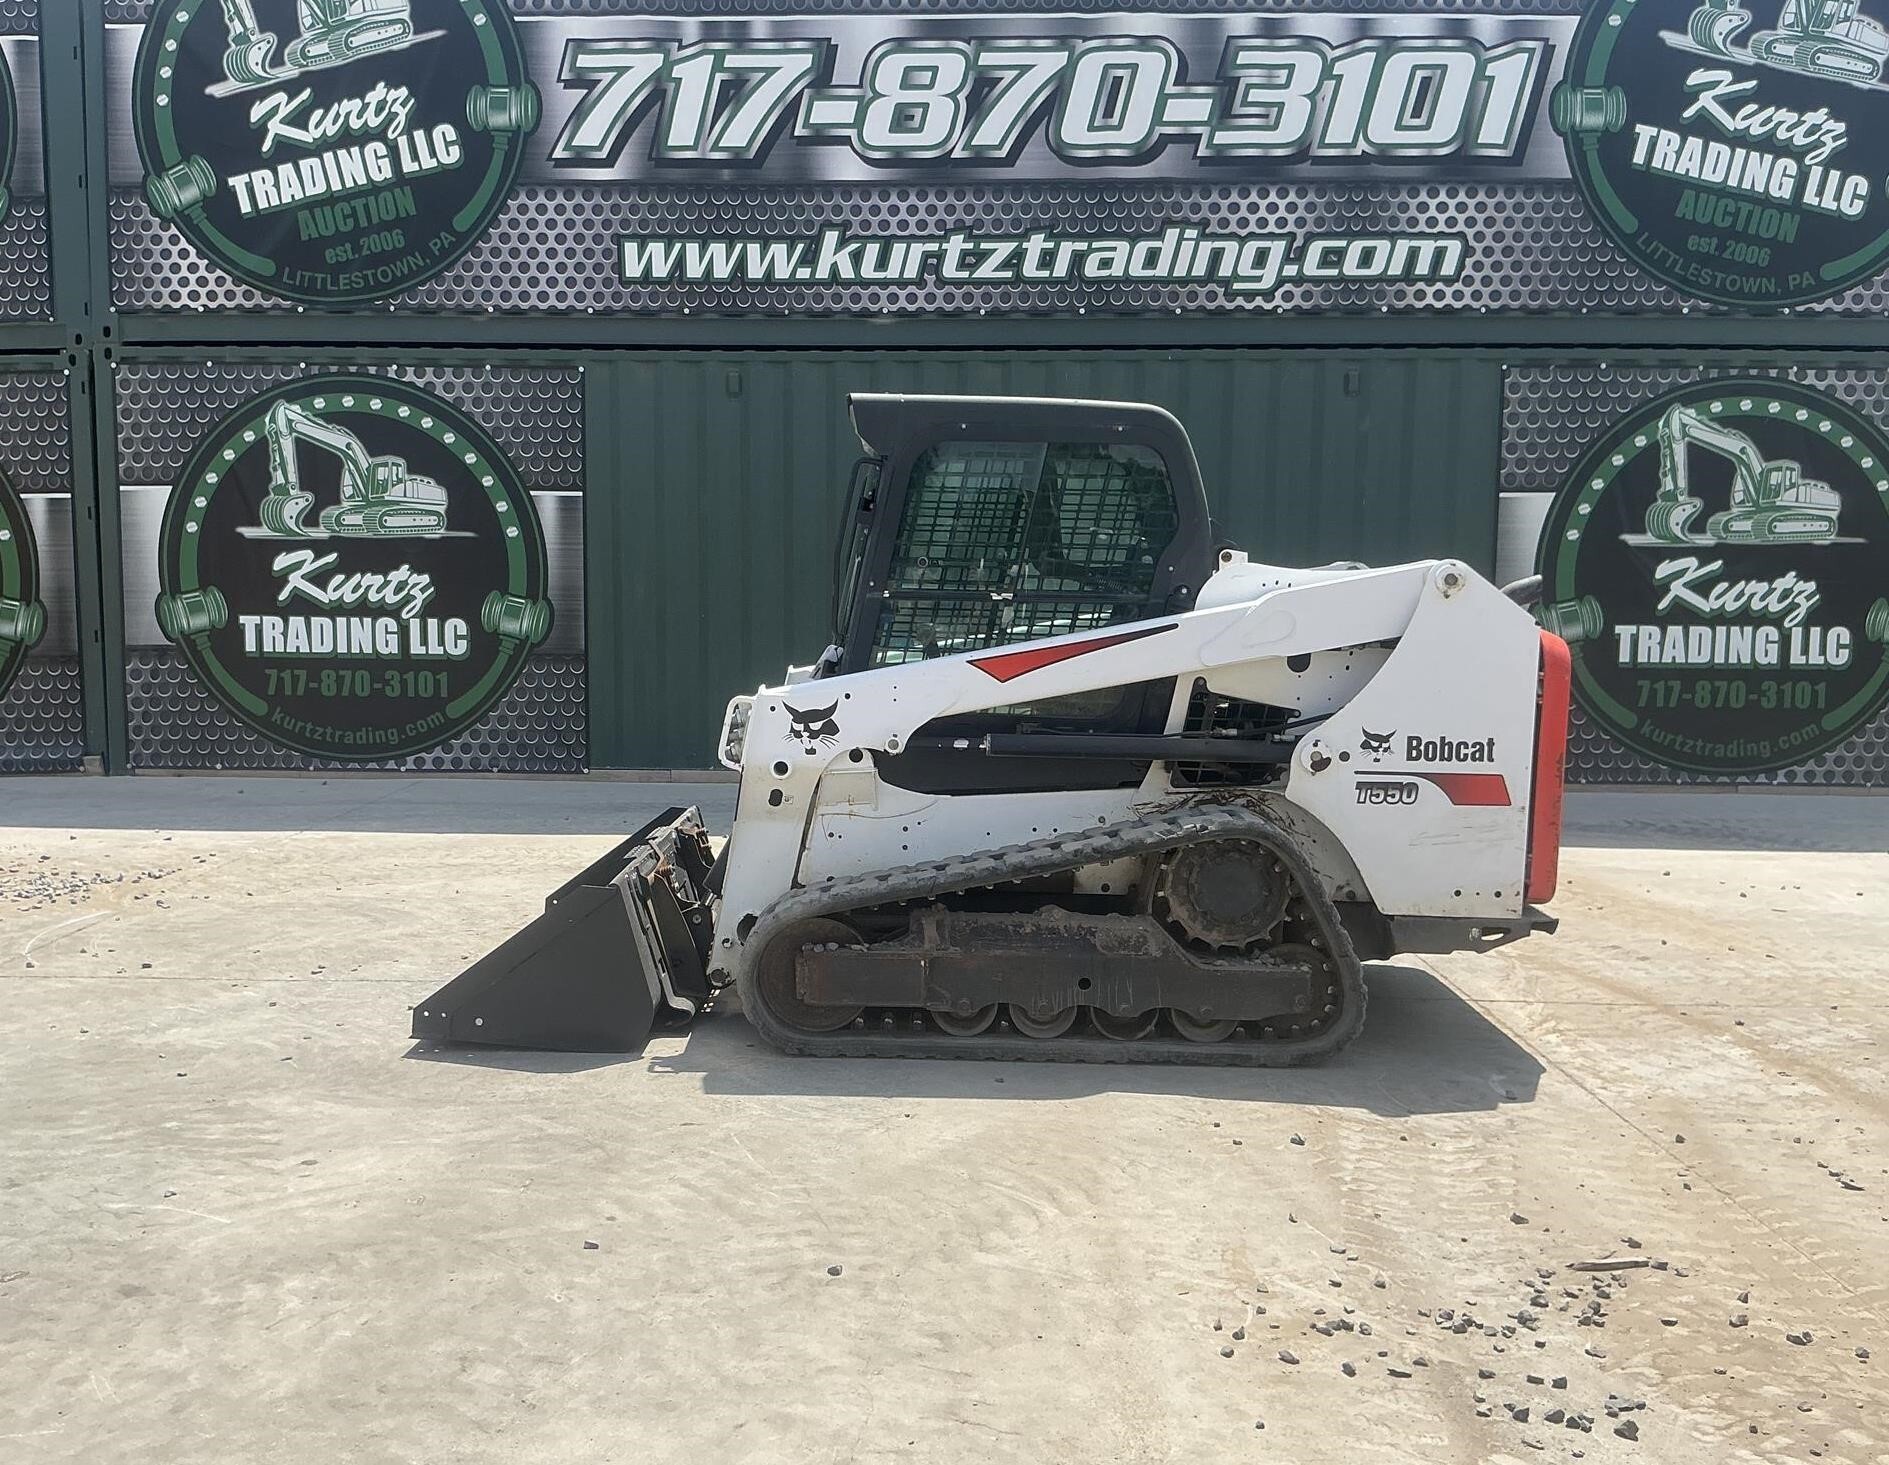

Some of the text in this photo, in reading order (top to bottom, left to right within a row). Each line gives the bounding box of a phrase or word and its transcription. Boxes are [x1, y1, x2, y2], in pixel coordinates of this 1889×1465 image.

[250, 81, 414, 152] Kurtz
[552, 36, 1548, 163] 717-870-3101
[1682, 68, 1848, 164] Kurtz
[228, 123, 462, 215] TRADING LLC
[1632, 124, 1869, 216] TRADING LLC
[297, 185, 416, 242] AUCTION
[1675, 190, 1801, 244] AUCTION
[281, 230, 457, 291] LITTLESTOWN, PA
[324, 231, 406, 264] est. 2006
[620, 226, 1466, 294] www.kurtztrading.com
[1635, 231, 1816, 295] LITTLESTOWN, PA
[1687, 235, 1772, 268] est. 2006
[273, 550, 434, 619] Kurtz
[1655, 556, 1819, 629] Kurtz
[239, 616, 470, 657] TRADING LLC
[1615, 625, 1851, 666] TRADING LLC
[265, 669, 449, 698] 717-870-3101
[1636, 680, 1826, 708] 717-870-3101
[271, 707, 446, 745] kurtztrading.com
[1406, 735, 1495, 762] Bobcat
[1640, 720, 1820, 758] kurtztrading.com
[1355, 781, 1420, 805] T550
